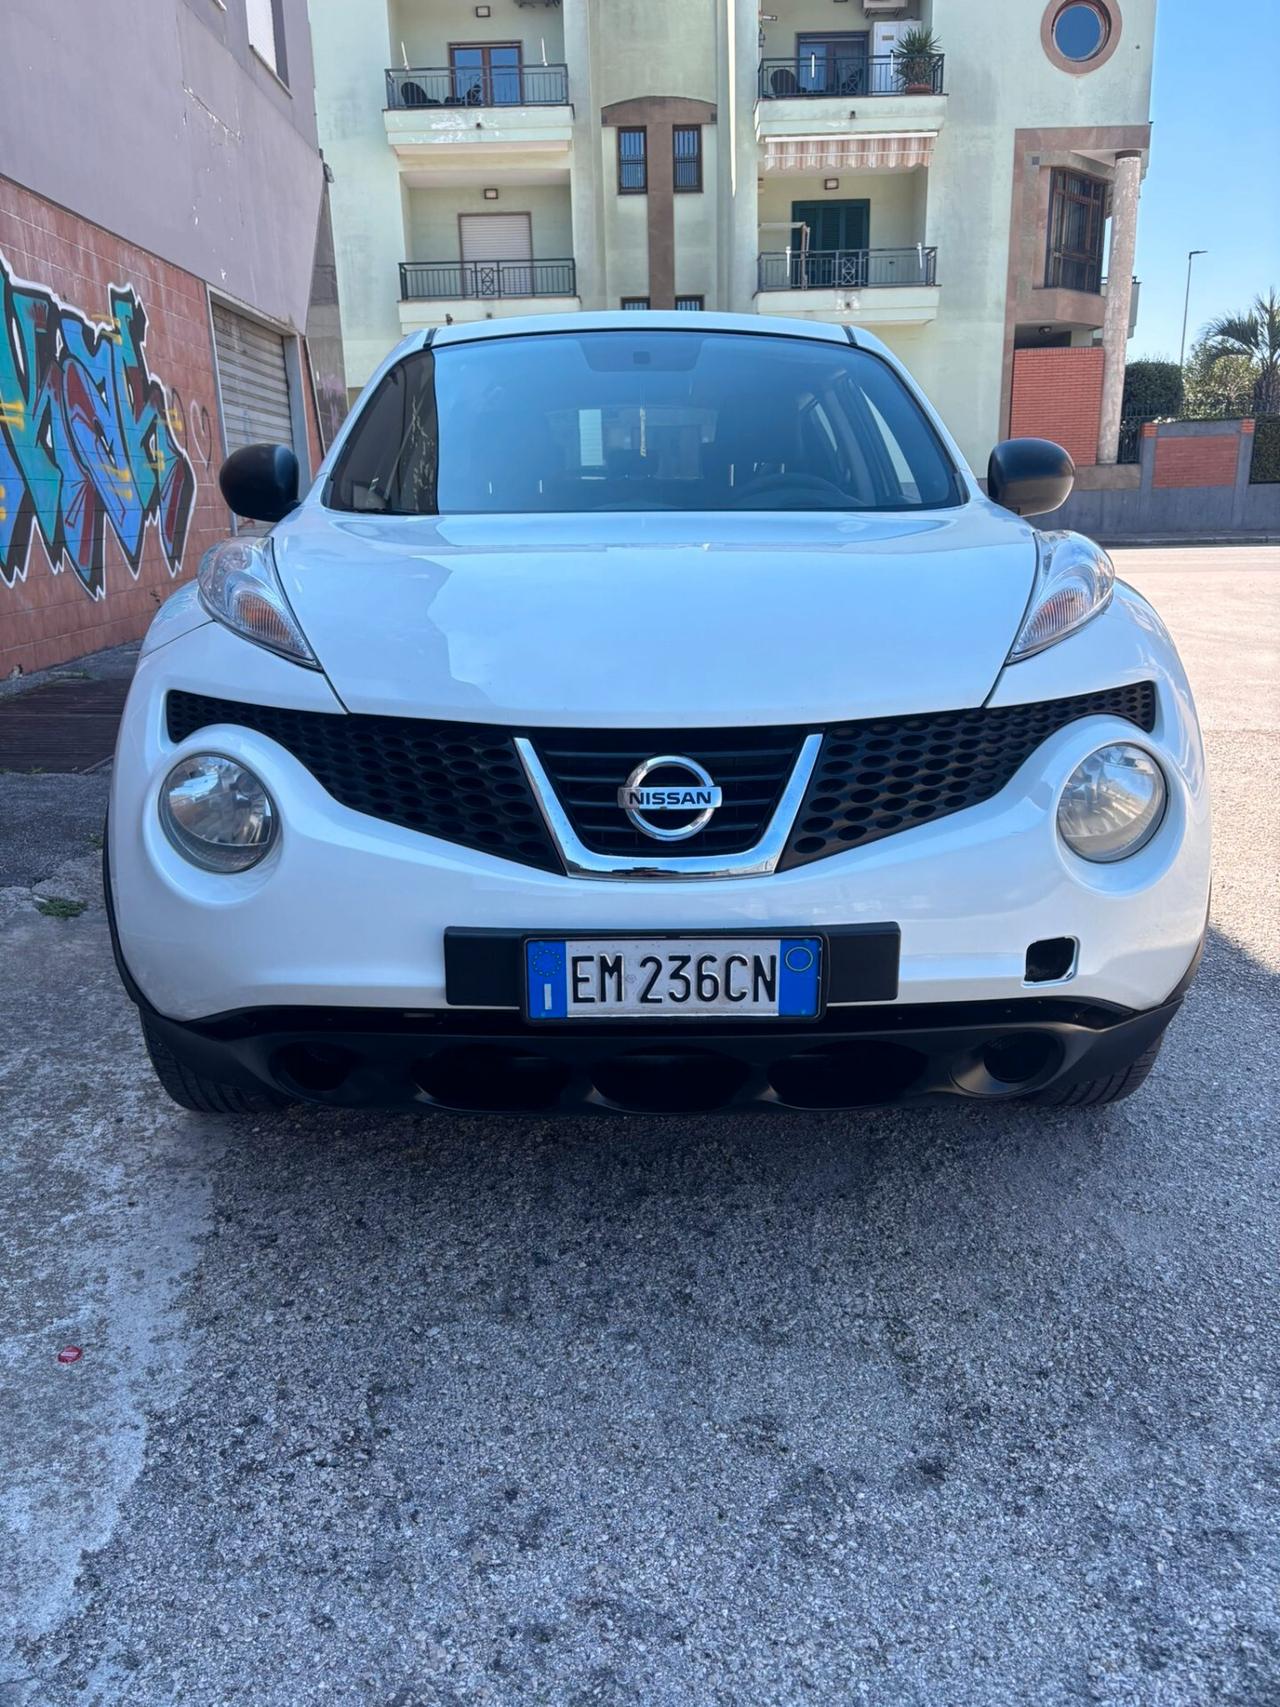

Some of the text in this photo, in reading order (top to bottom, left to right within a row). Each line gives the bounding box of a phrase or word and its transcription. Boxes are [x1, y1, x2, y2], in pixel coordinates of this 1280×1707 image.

[629, 791, 712, 805] NISSAN
[571, 954, 777, 1004] EM 236CN
[544, 983, 552, 1010] I
